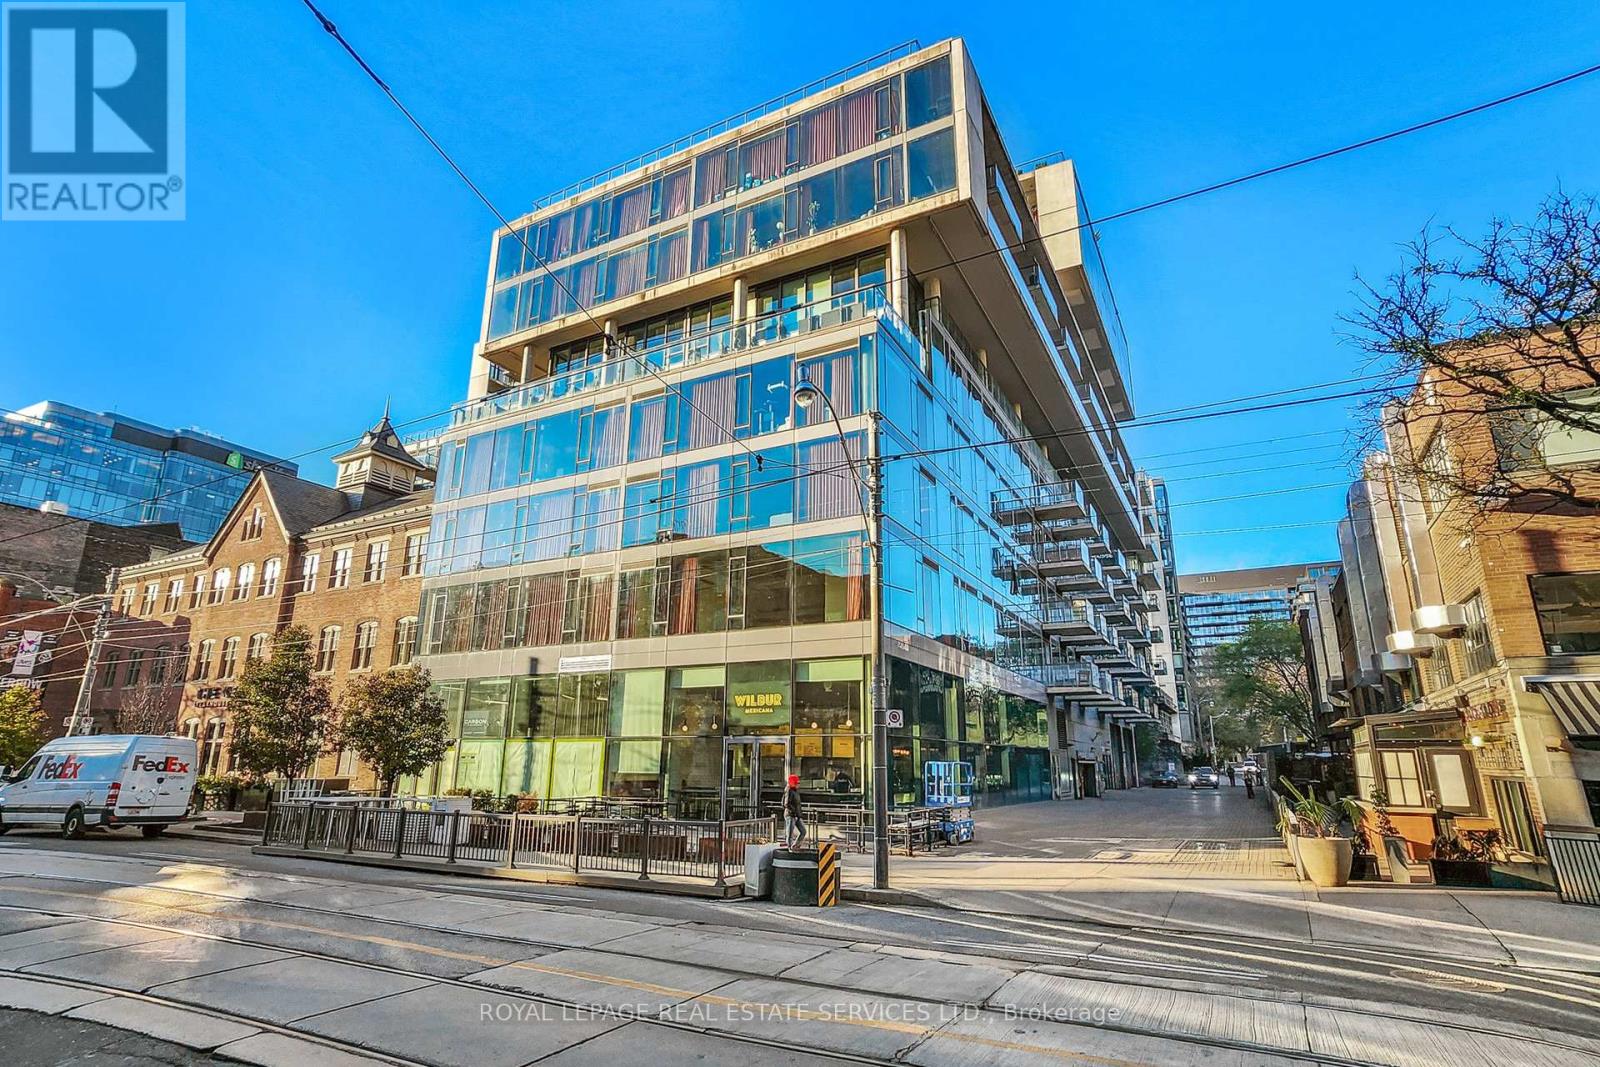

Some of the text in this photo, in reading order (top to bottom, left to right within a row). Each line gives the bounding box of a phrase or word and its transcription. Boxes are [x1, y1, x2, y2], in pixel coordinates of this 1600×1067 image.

[734, 693, 782, 707] WILBUR
[37, 754, 83, 779] FedEx
[132, 755, 190, 773] FedEx
